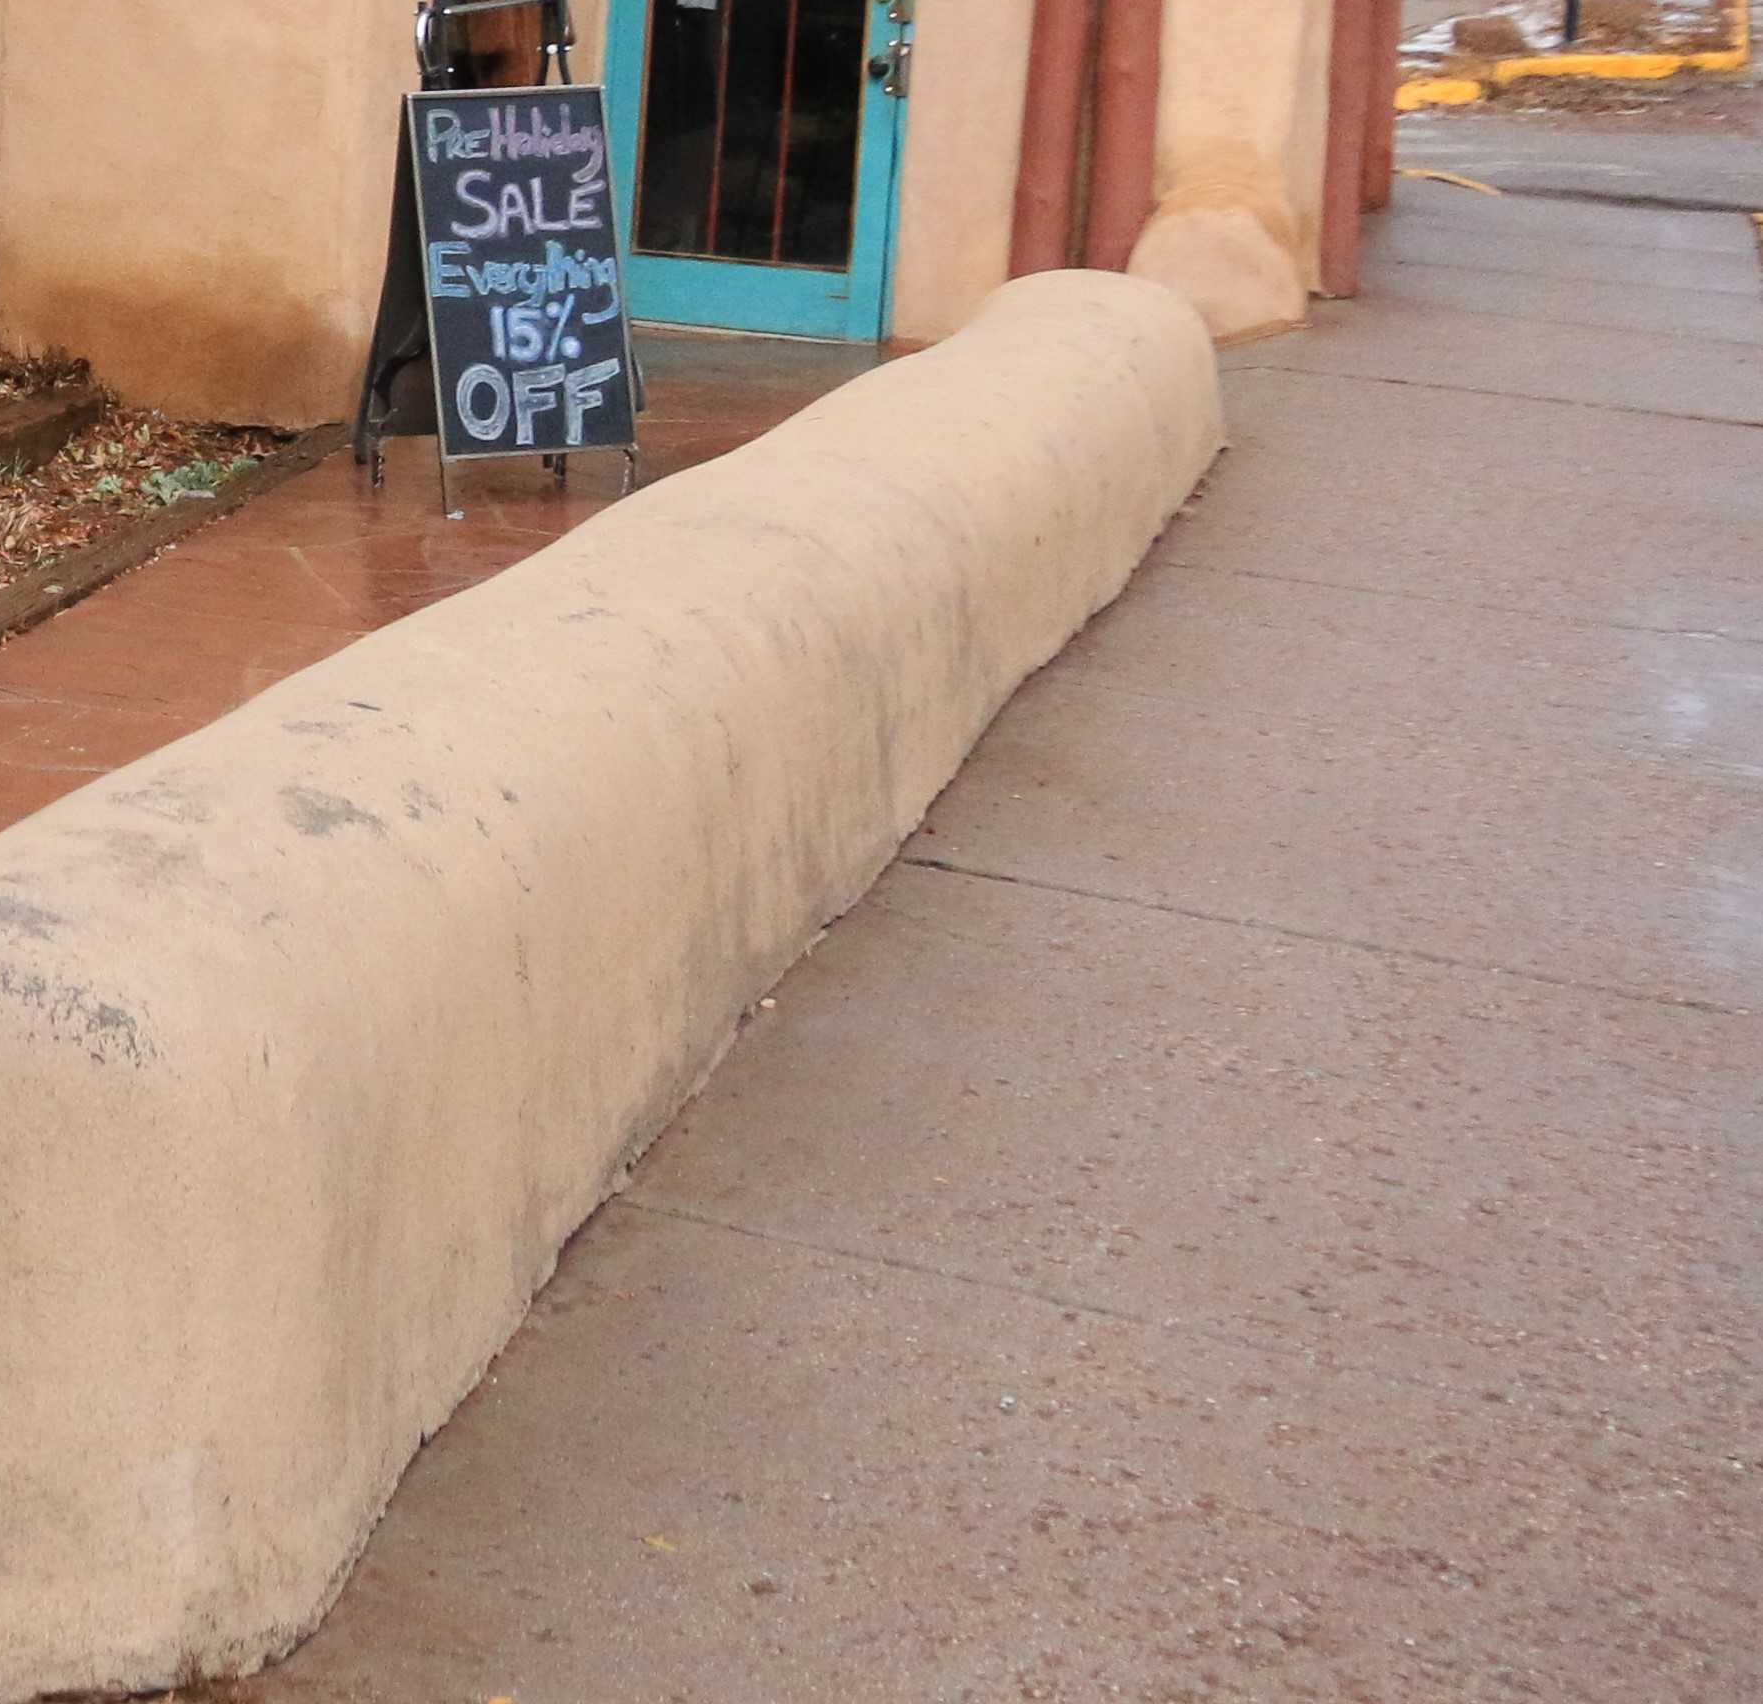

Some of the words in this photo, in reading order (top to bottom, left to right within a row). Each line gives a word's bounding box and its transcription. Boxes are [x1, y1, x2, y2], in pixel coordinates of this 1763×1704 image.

[450, 169, 607, 239] SALE
[428, 239, 618, 325] Everything
[489, 293, 582, 363] 15%
[456, 358, 621, 446] OFF
